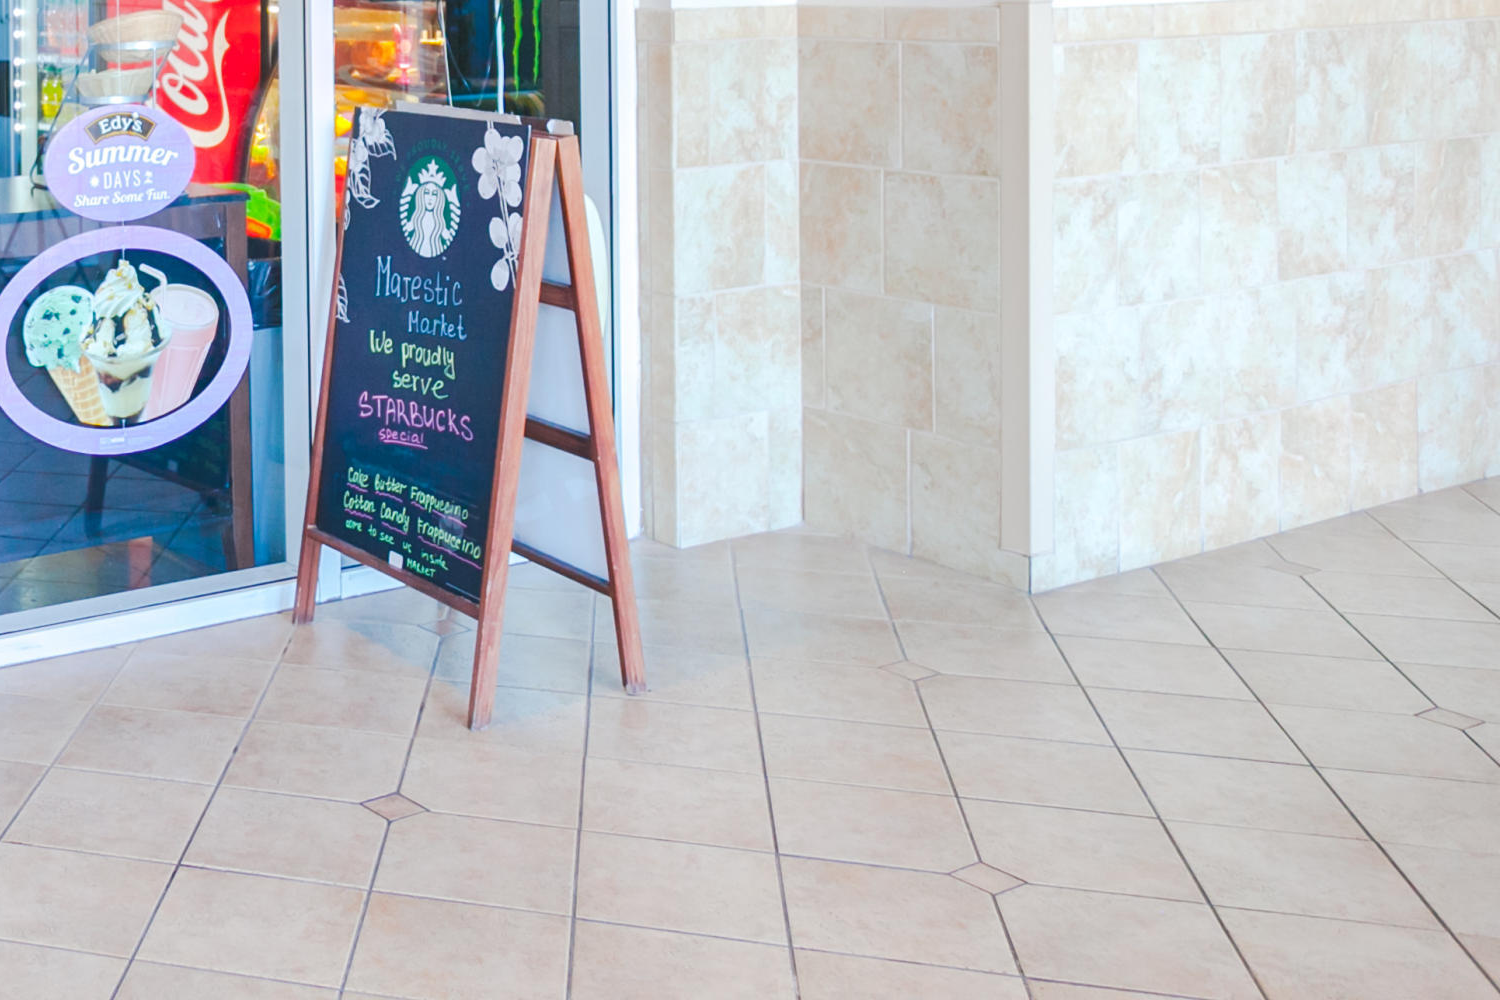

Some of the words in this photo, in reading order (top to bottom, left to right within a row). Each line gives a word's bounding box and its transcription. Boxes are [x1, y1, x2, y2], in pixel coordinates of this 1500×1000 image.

[98, 112, 144, 134] Edy's
[68, 144, 179, 175] Summer
[103, 169, 141, 190] DAYS
[73, 193, 110, 208] Share
[112, 190, 144, 205] Some
[146, 187, 171, 201] Fun.
[408, 310, 467, 340] Market
[369, 329, 394, 354] We
[402, 341, 455, 379] proudly
[392, 369, 449, 399] serve
[358, 390, 474, 441] STARBUCKS
[378, 428, 425, 445] special
[343, 490, 376, 513] Cotton
[380, 501, 410, 535] Candy
